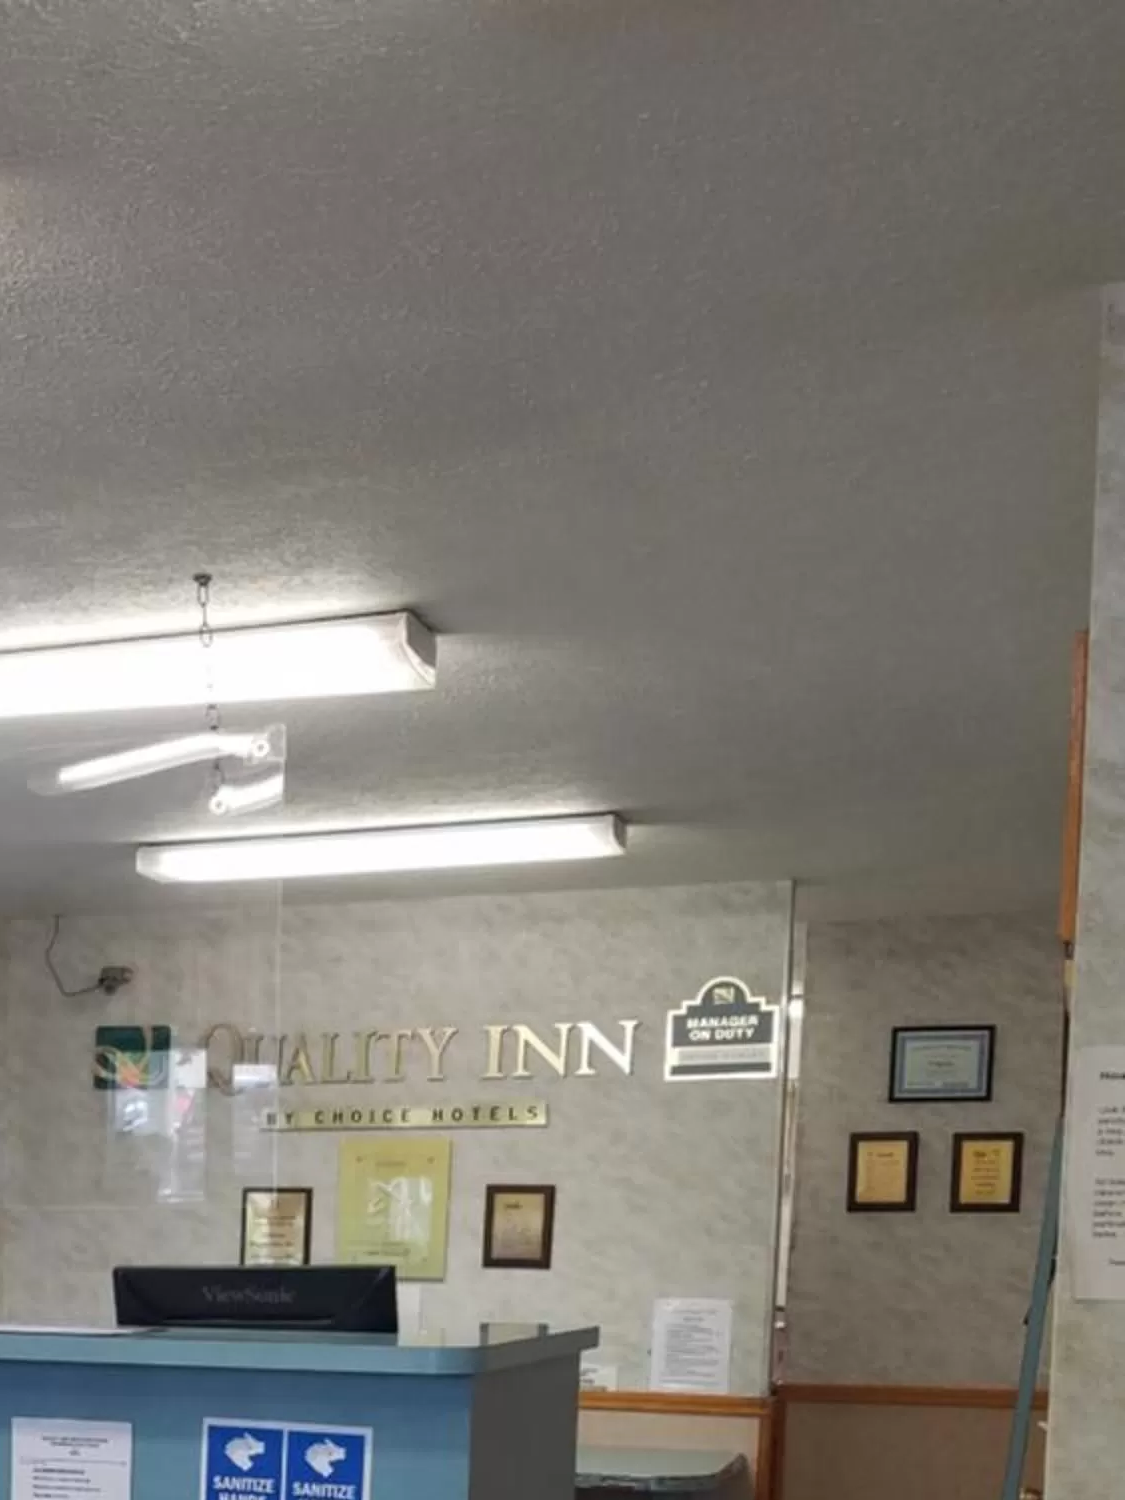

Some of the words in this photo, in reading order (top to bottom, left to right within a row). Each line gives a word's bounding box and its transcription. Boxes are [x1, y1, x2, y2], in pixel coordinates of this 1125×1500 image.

[686, 1014, 759, 1029] MANAGER
[688, 1029, 712, 1041] ON
[714, 1027, 756, 1040] DUTY
[204, 1022, 458, 1097] QUALITY
[480, 1019, 640, 1081] INN
[314, 1107, 412, 1125] CHOICE
[431, 1106, 540, 1123] HOTELS
[201, 1284, 297, 1306] ViewSonic
[213, 1475, 275, 1494] SANITIZE
[292, 1481, 357, 1500] SANITIZE
